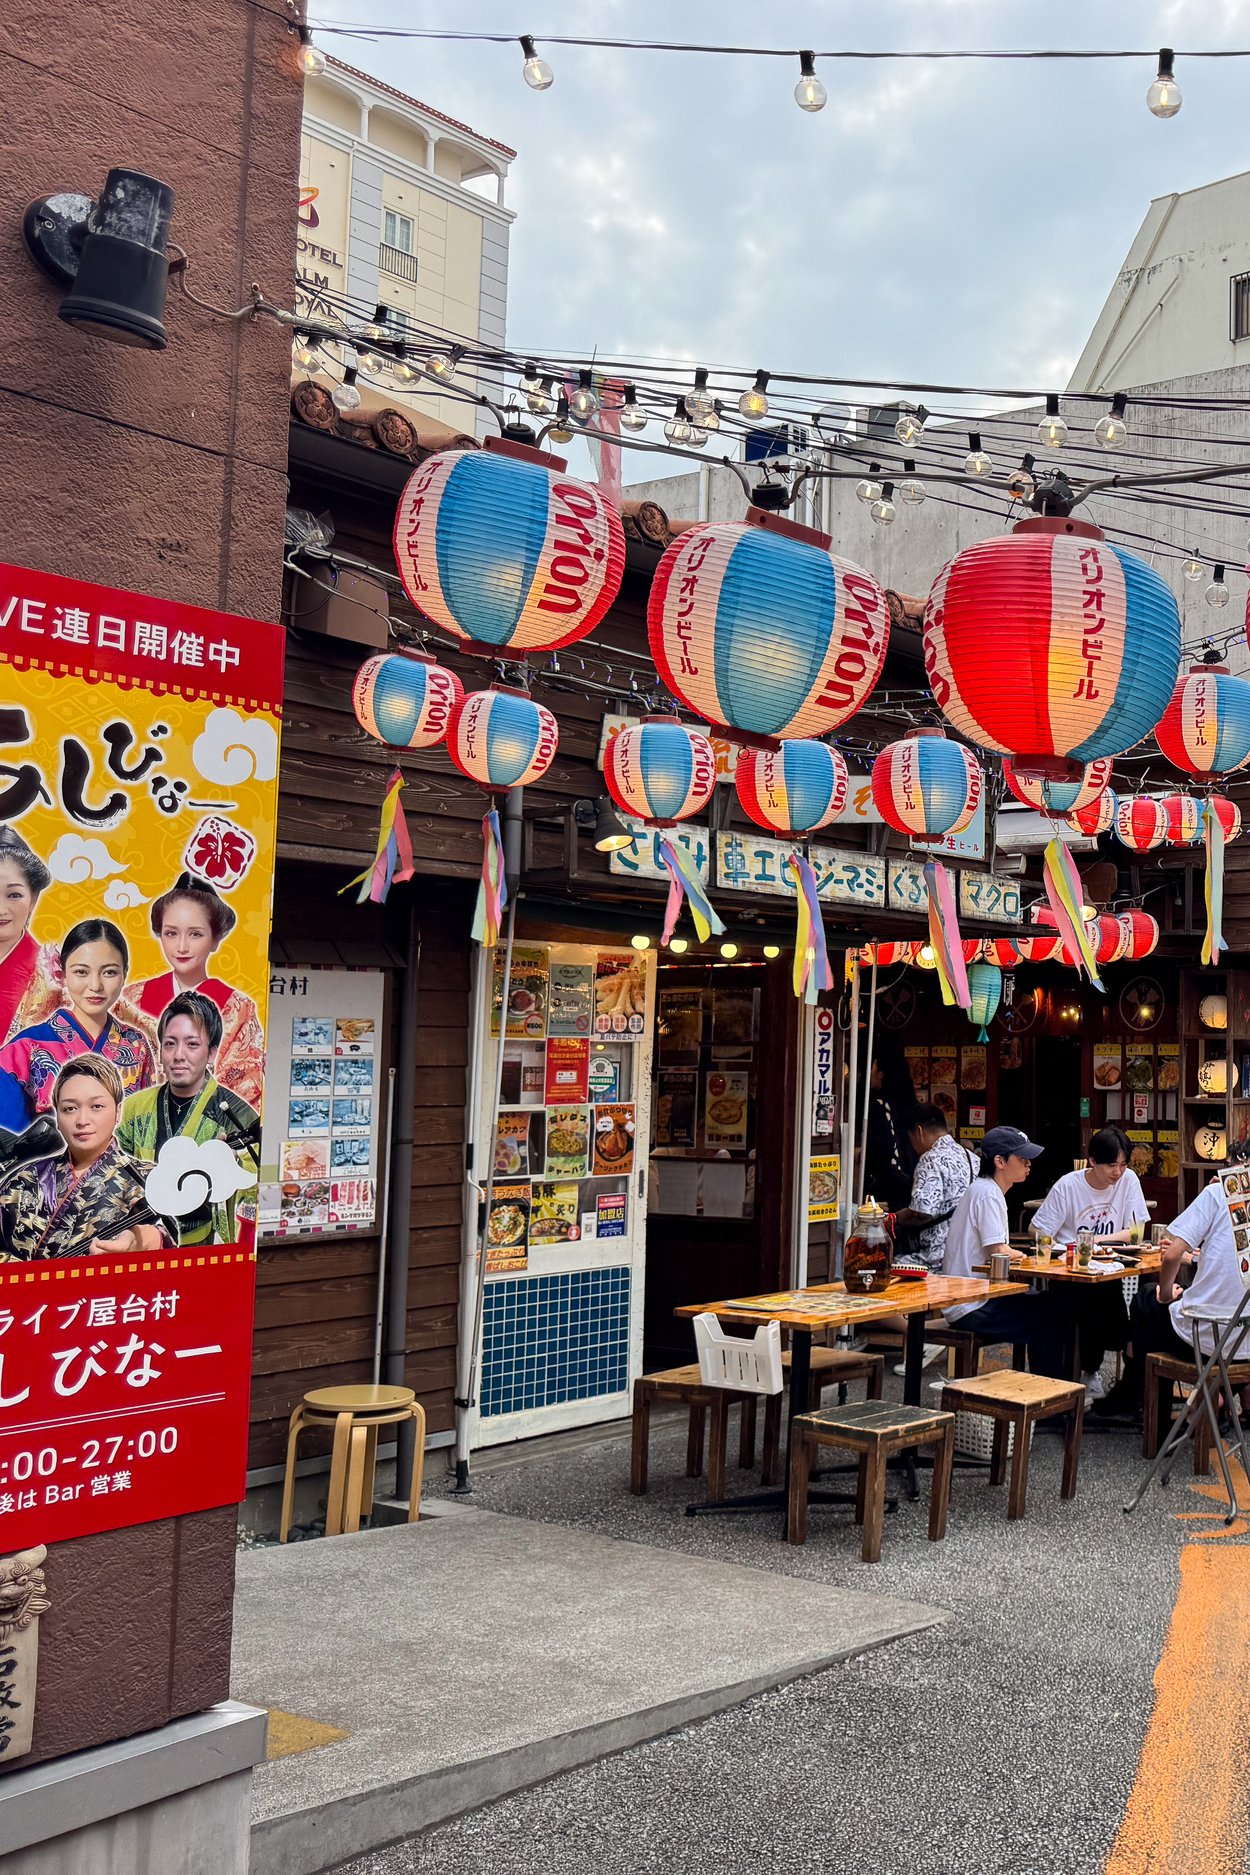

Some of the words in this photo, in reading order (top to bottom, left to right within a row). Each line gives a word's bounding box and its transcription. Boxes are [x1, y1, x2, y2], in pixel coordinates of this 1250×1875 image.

[407, 461, 444, 591] オリオンビール
[537, 483, 605, 614] Orion
[676, 537, 716, 676] オリオンビール
[1073, 547, 1106, 700] オリオンビール
[814, 573, 881, 709] Orion
[359, 660, 380, 720] オリオンビール
[423, 673, 453, 734] Orion
[1195, 679, 1207, 746] オリオンビール
[466, 697, 486, 759] オリオンビール
[532, 710, 559, 772] Orion
[620, 731, 635, 794] オリオンビール
[690, 733, 715, 797] Orion
[764, 750, 779, 808] リオンビール
[901, 745, 916, 811] オリオンビール
[963, 747, 981, 812] Orion
[1119, 803, 1130, 836] Orion
[965, 879, 1020, 918] マグロ
[817, 1032, 831, 1095] アカマル
[45, 1482, 85, 1506] Bar
[90, 1470, 133, 1498] 営業
